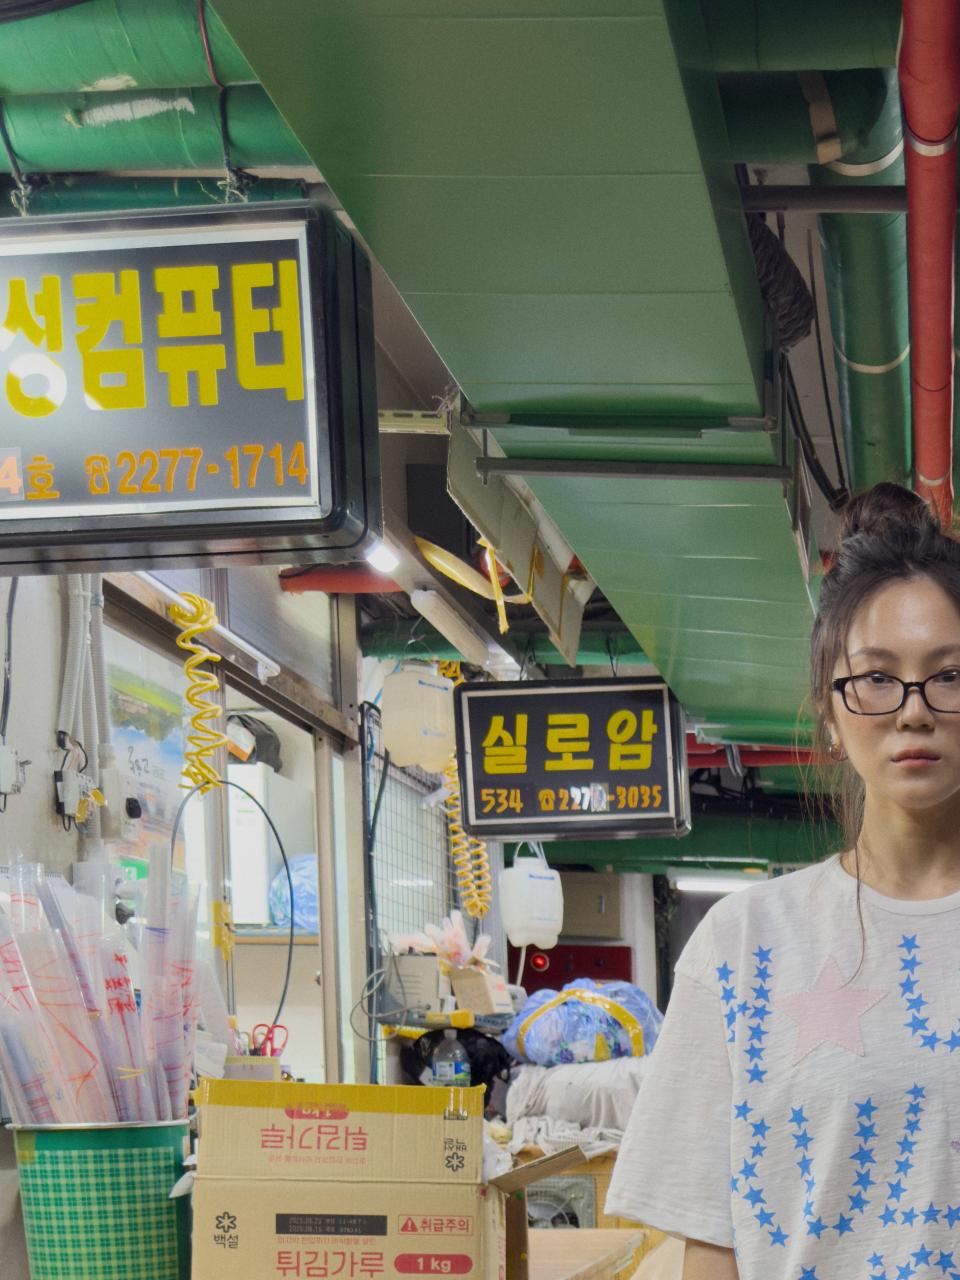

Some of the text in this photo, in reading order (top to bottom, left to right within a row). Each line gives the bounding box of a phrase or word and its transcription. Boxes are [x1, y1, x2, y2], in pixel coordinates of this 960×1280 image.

[2, 259, 305, 418] 성컴퓨터
[481, 709, 658, 775] 실로암
[480, 788, 524, 814] 534
[260, 1124, 368, 1151] 튀김가루
[420, 1217, 470, 1233] 취급주의
[213, 1234, 239, 1249] 백설
[275, 1251, 452, 1279] 튀김가루 1 kg
